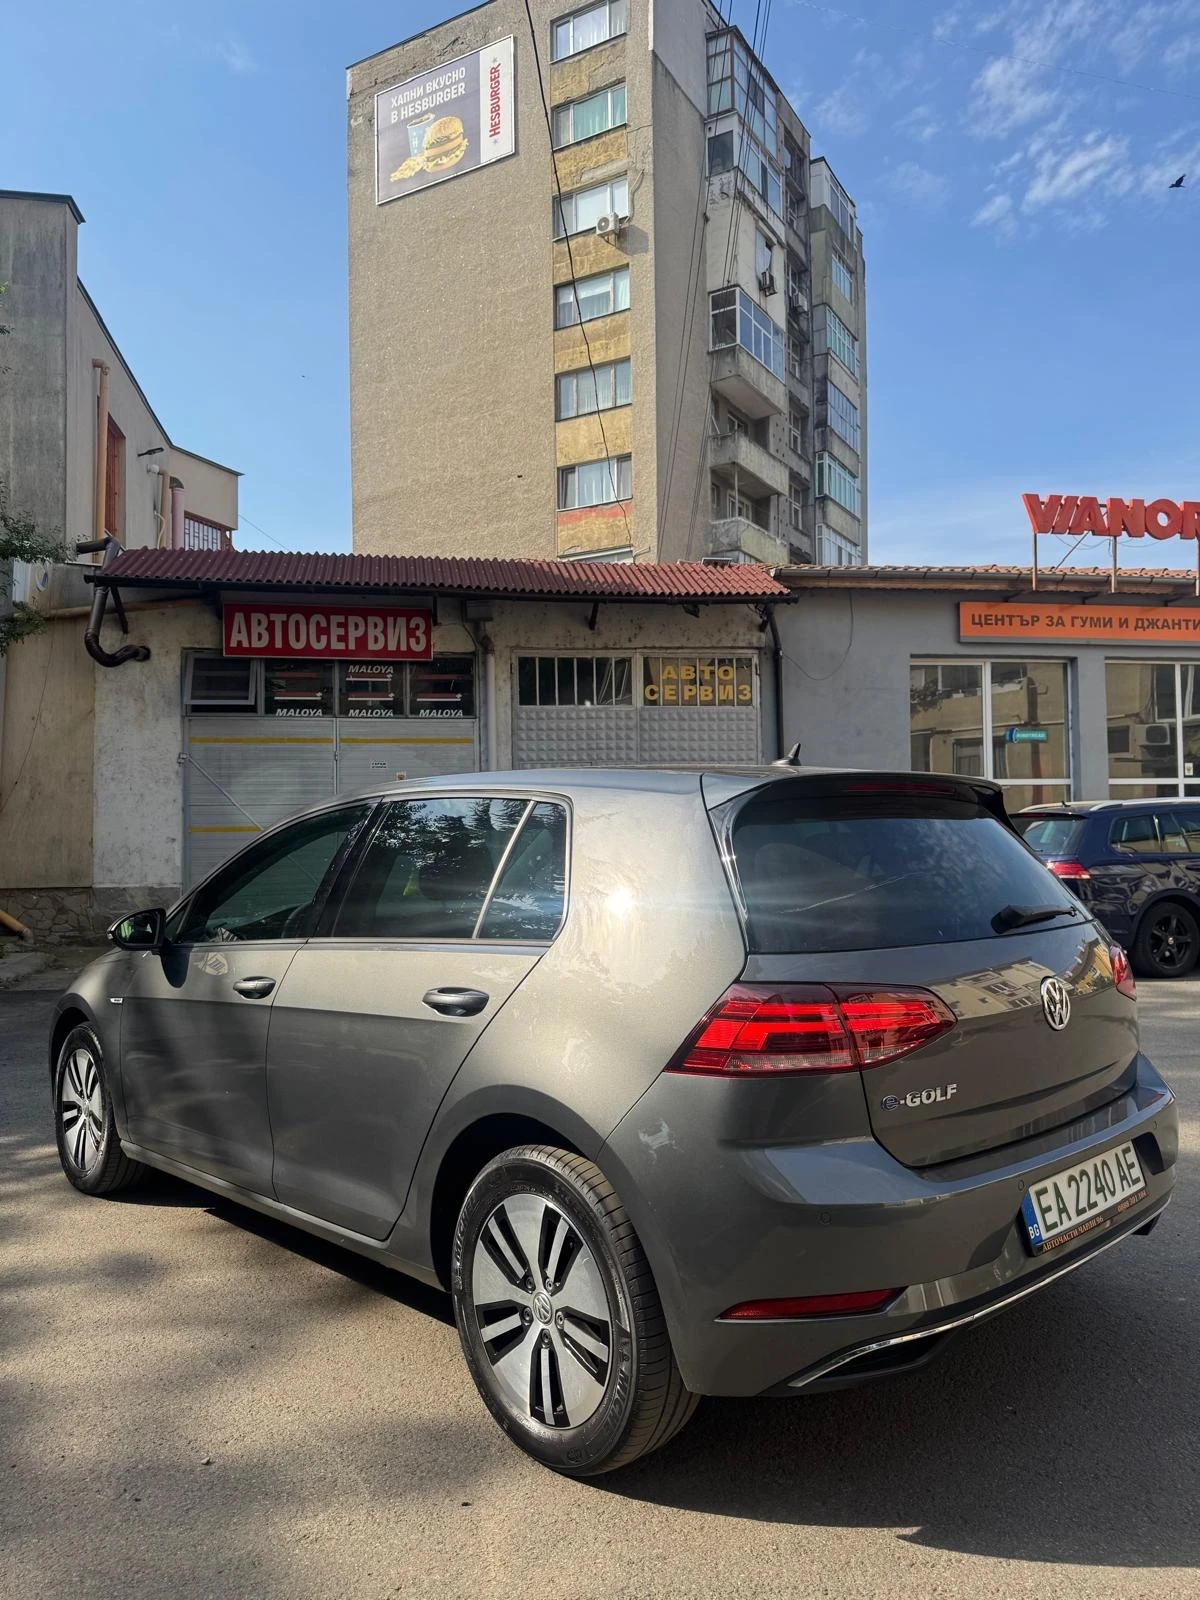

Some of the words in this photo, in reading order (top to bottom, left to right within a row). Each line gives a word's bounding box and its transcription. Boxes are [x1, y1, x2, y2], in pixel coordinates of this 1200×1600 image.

[391, 85, 424, 108] ХАПНИ
[426, 67, 466, 94] ВКУСНО
[400, 82, 466, 120] HESBURGER
[489, 63, 501, 138] HESBURGER
[971, 613, 1040, 628] ЦЕНТЪР
[1045, 615, 1066, 628] ЗА
[1070, 616, 1113, 629] ГУМИ
[1118, 617, 1129, 629] И
[229, 611, 427, 653] АВТОСЕРВИЗ
[348, 665, 394, 674] MALOYA
[662, 665, 735, 680] АВТО
[644, 684, 752, 701] СЕРВИЗ
[275, 708, 323, 717] MALOYA
[348, 708, 394, 717] MALOYA
[418, 709, 464, 718] MALOYA
[1036, 1182, 1072, 1233] EA
[1068, 1159, 1116, 1217] 2240
[1114, 1145, 1141, 1193] AE
[1028, 1224, 1040, 1239] BG
[1042, 1228, 1079, 1252] АВТОЧАСТИ
